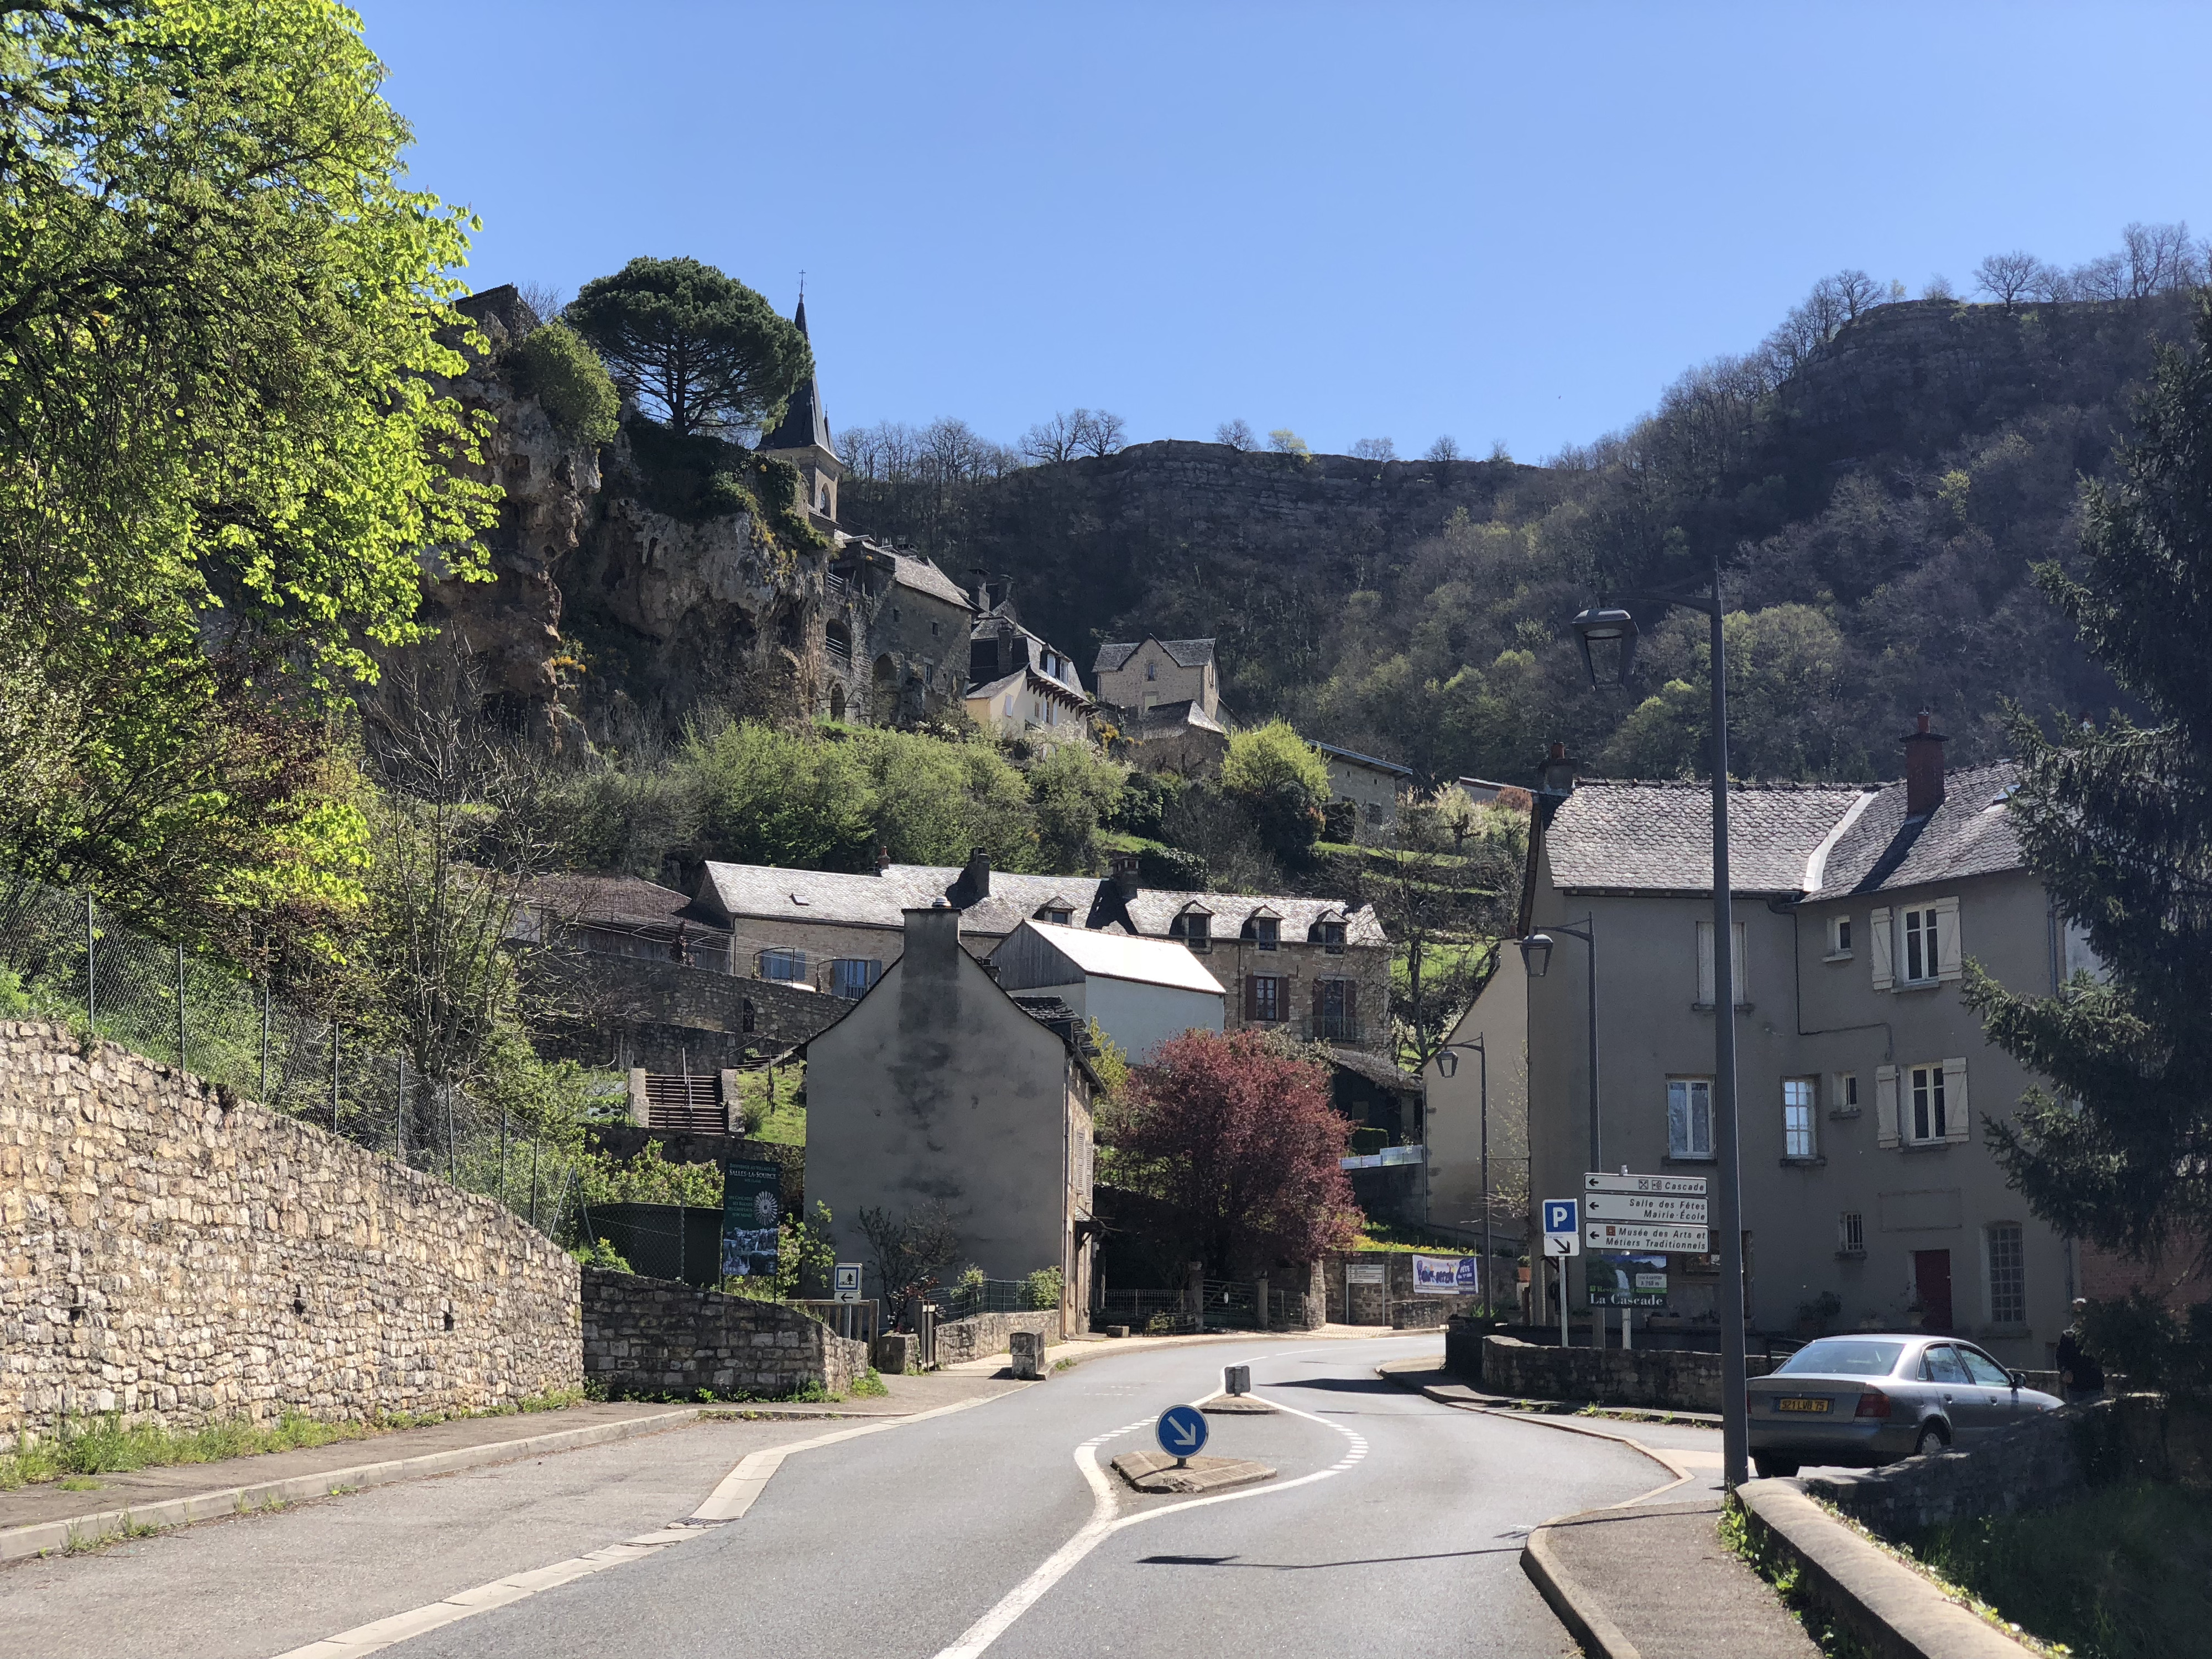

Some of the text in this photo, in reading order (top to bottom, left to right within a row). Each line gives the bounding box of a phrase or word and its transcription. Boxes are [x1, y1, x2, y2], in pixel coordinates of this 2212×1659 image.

[1665, 1182, 1704, 1191] Cascade
[1629, 1198, 1705, 1211] Salle des Fêtes
[1553, 1207, 1567, 1228] P
[1619, 1227, 1648, 1237] Musée
[1653, 1229, 1668, 1237] des
[1673, 1230, 1692, 1239] Arts
[1606, 1237, 1705, 1250] Métiers Traditionnels
[1590, 1293, 1663, 1306] La Cascade
